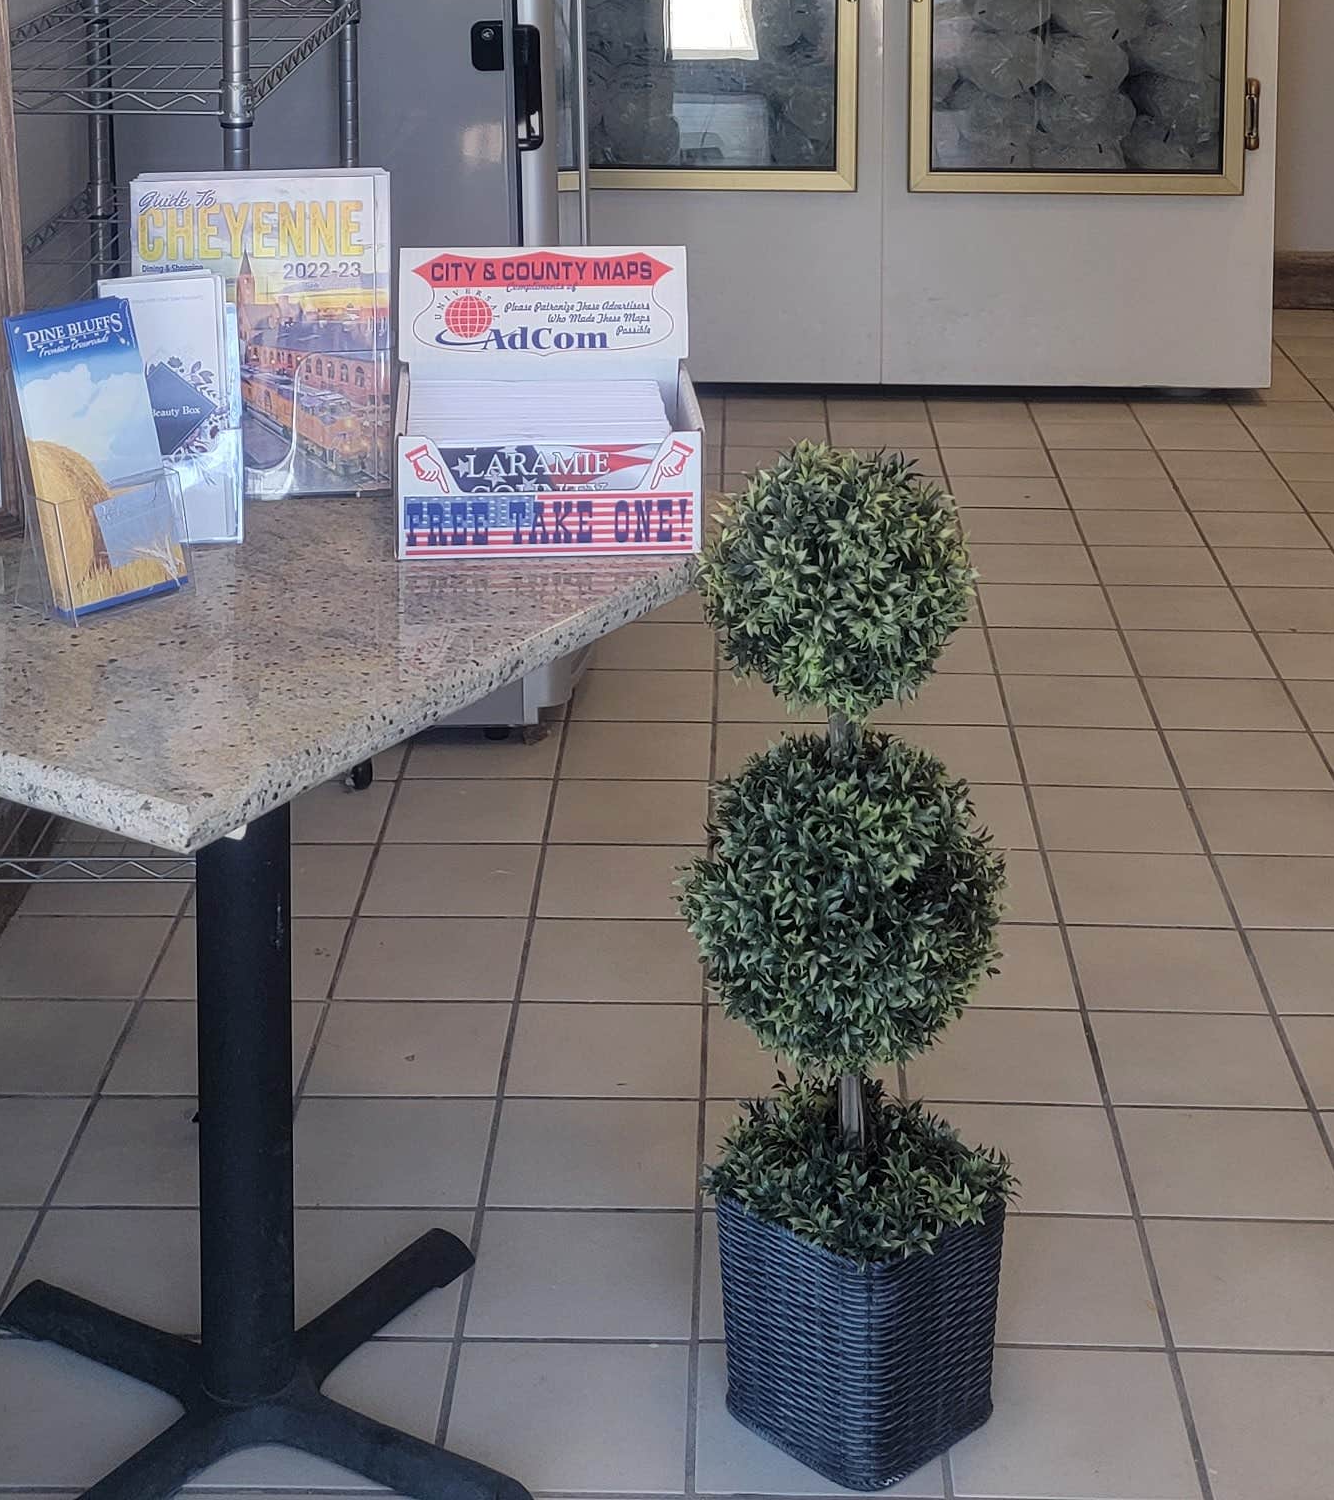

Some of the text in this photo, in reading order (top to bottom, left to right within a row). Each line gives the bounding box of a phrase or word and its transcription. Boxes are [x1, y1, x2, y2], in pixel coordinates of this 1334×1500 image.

[138, 189, 217, 213] Guide To
[138, 200, 365, 261] CHEYENNE
[141, 263, 164, 274] Dining
[283, 262, 362, 280] 2022-23
[431, 261, 653, 282] CITY & COUNTY MAPS
[506, 282, 578, 293] Compliments of
[504, 301, 651, 314] Please Patronize These Advertisers
[547, 313, 651, 324] Who Made These Maps
[23, 312, 123, 352] PINE BLUFFS
[481, 326, 610, 350] AdCom
[616, 325, 651, 337] Possible
[38, 345, 70, 358] Frontier
[182, 405, 201, 415] Box
[464, 451, 612, 478] LARAMIE
[406, 498, 688, 546] FREE TAKE ONE!
